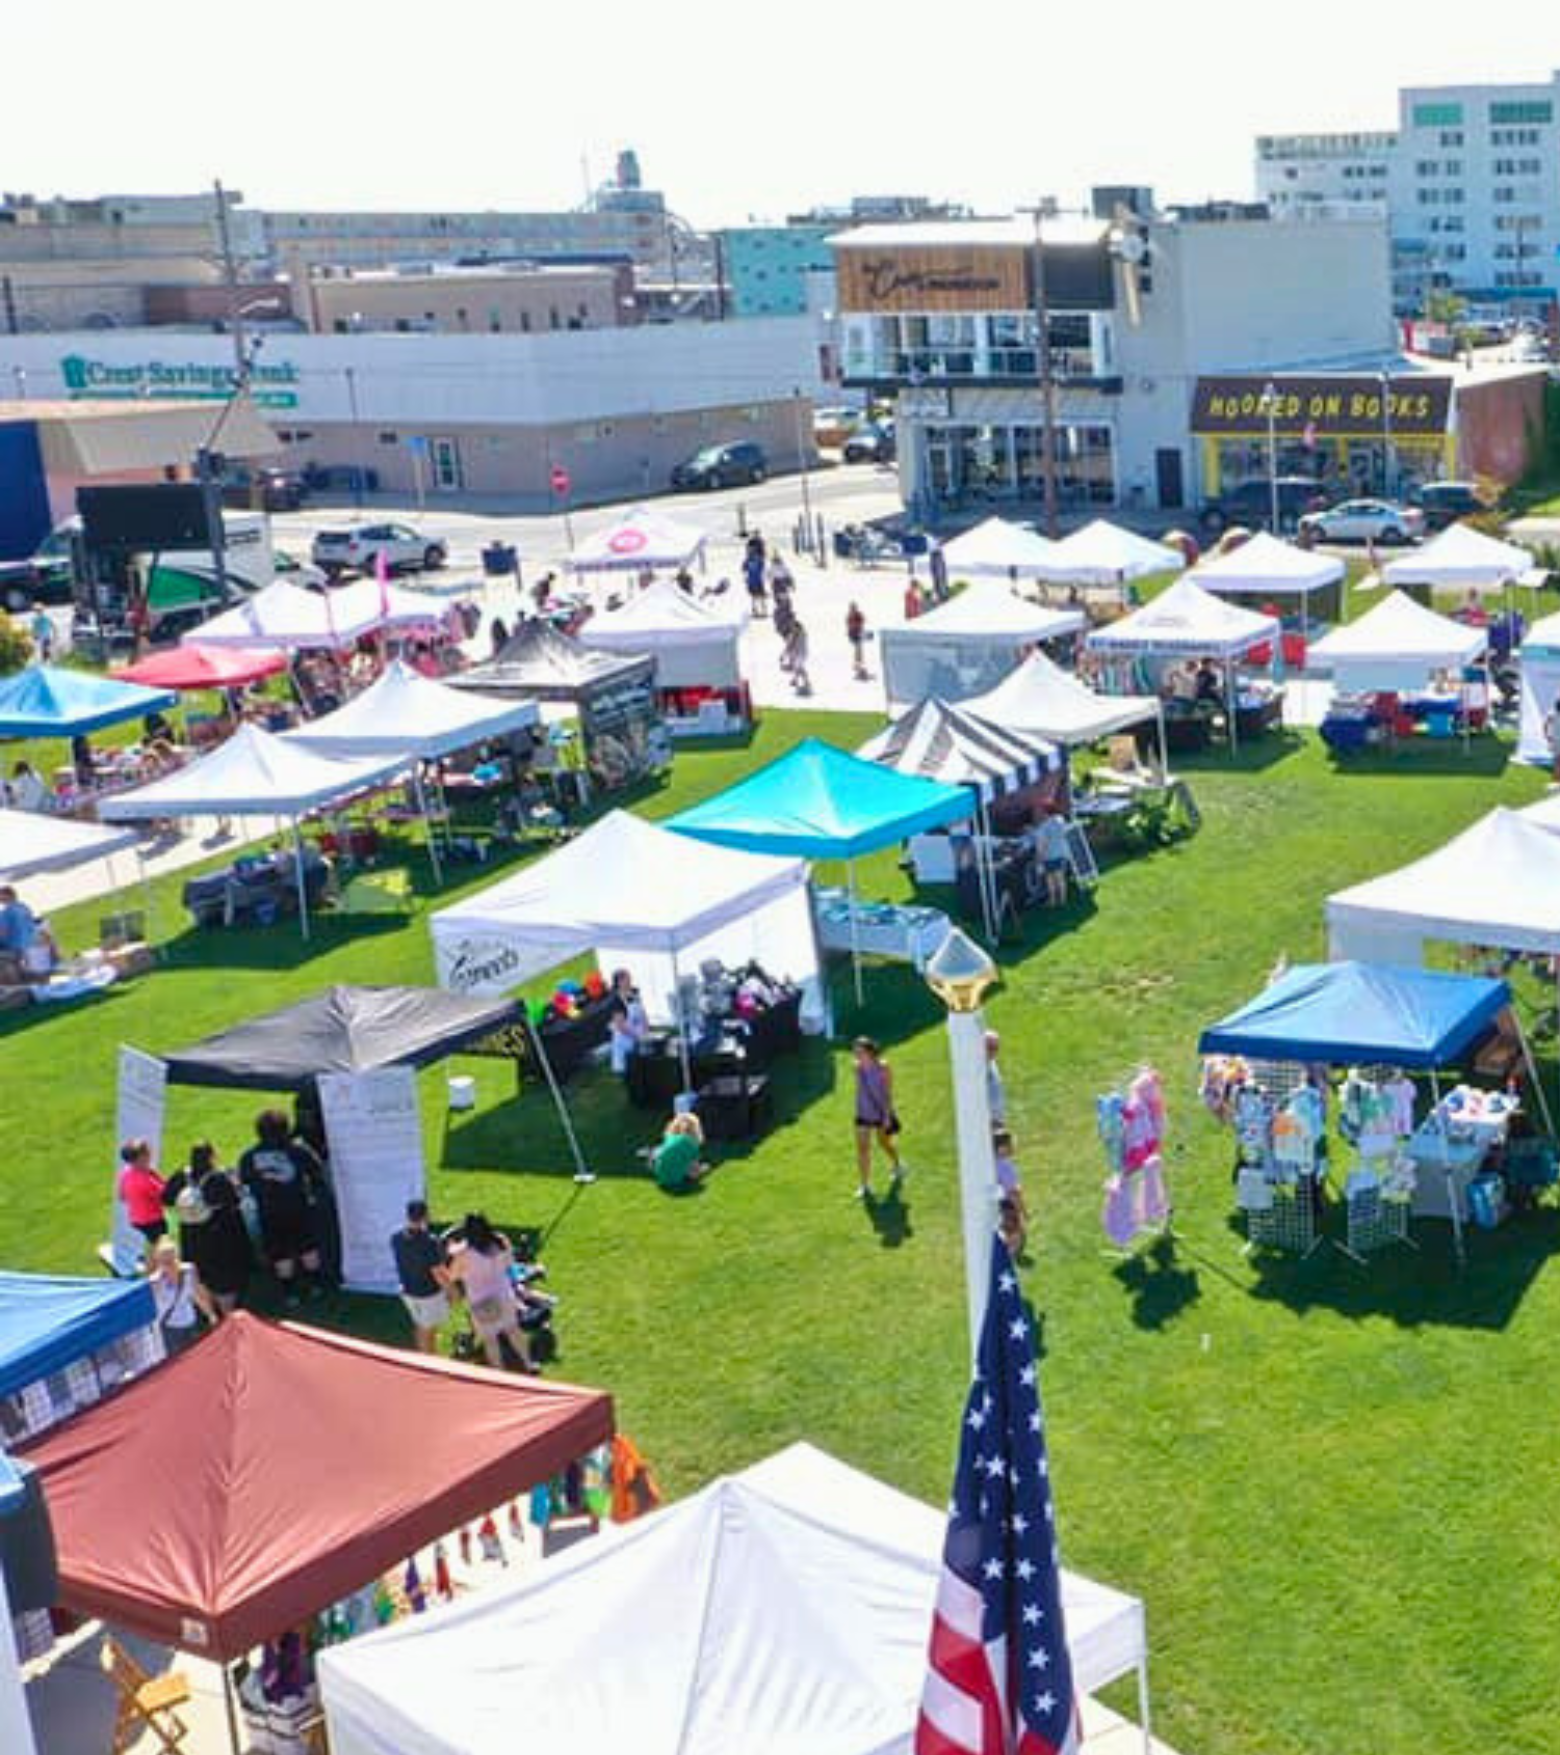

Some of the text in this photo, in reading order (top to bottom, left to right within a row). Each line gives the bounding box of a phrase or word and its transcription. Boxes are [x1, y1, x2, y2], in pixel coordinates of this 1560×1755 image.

[86, 361, 299, 388] Crest Savings ank
[1210, 394, 1430, 418] HOOKED ON BOOKS
